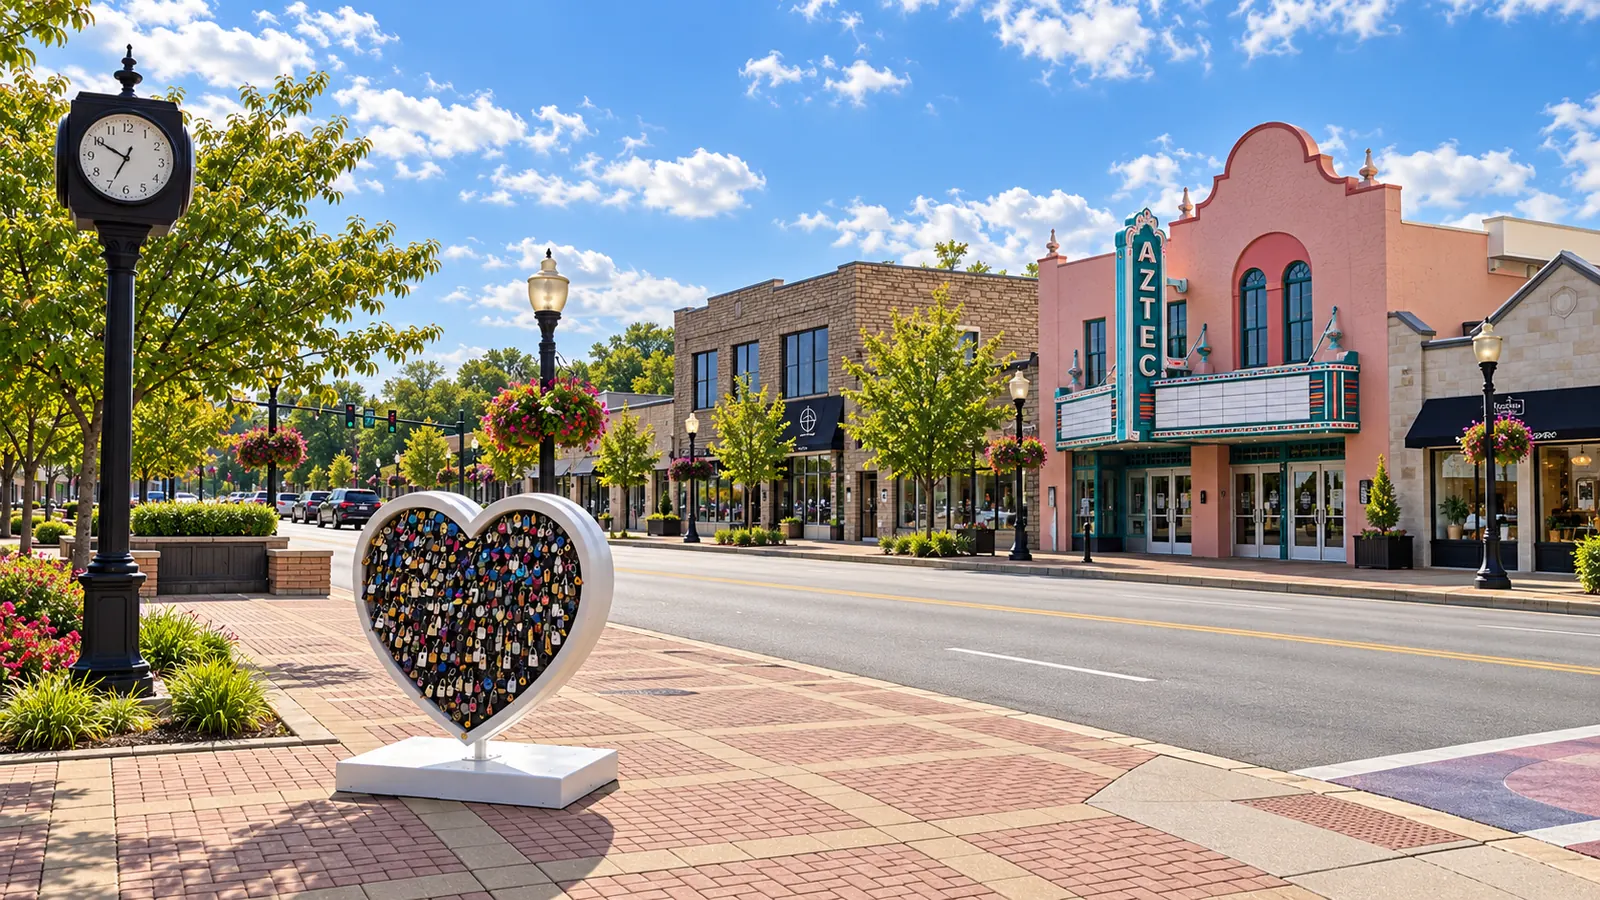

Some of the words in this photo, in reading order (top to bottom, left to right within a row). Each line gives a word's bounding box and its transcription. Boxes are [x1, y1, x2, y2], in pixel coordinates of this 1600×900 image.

[107, 126, 115, 135] 11
[123, 123, 133, 133] 12
[143, 130, 147, 138] 1
[94, 136, 104, 146] 10
[154, 142, 160, 151] 2
[88, 152, 94, 160] 9
[158, 158, 164, 168] 3
[93, 168, 100, 176] 8
[152, 174, 158, 183] 4
[106, 180, 113, 189] 7
[140, 184, 146, 192] 5
[123, 185, 129, 194] 6
[1137, 241, 1157, 376] AZTEC
